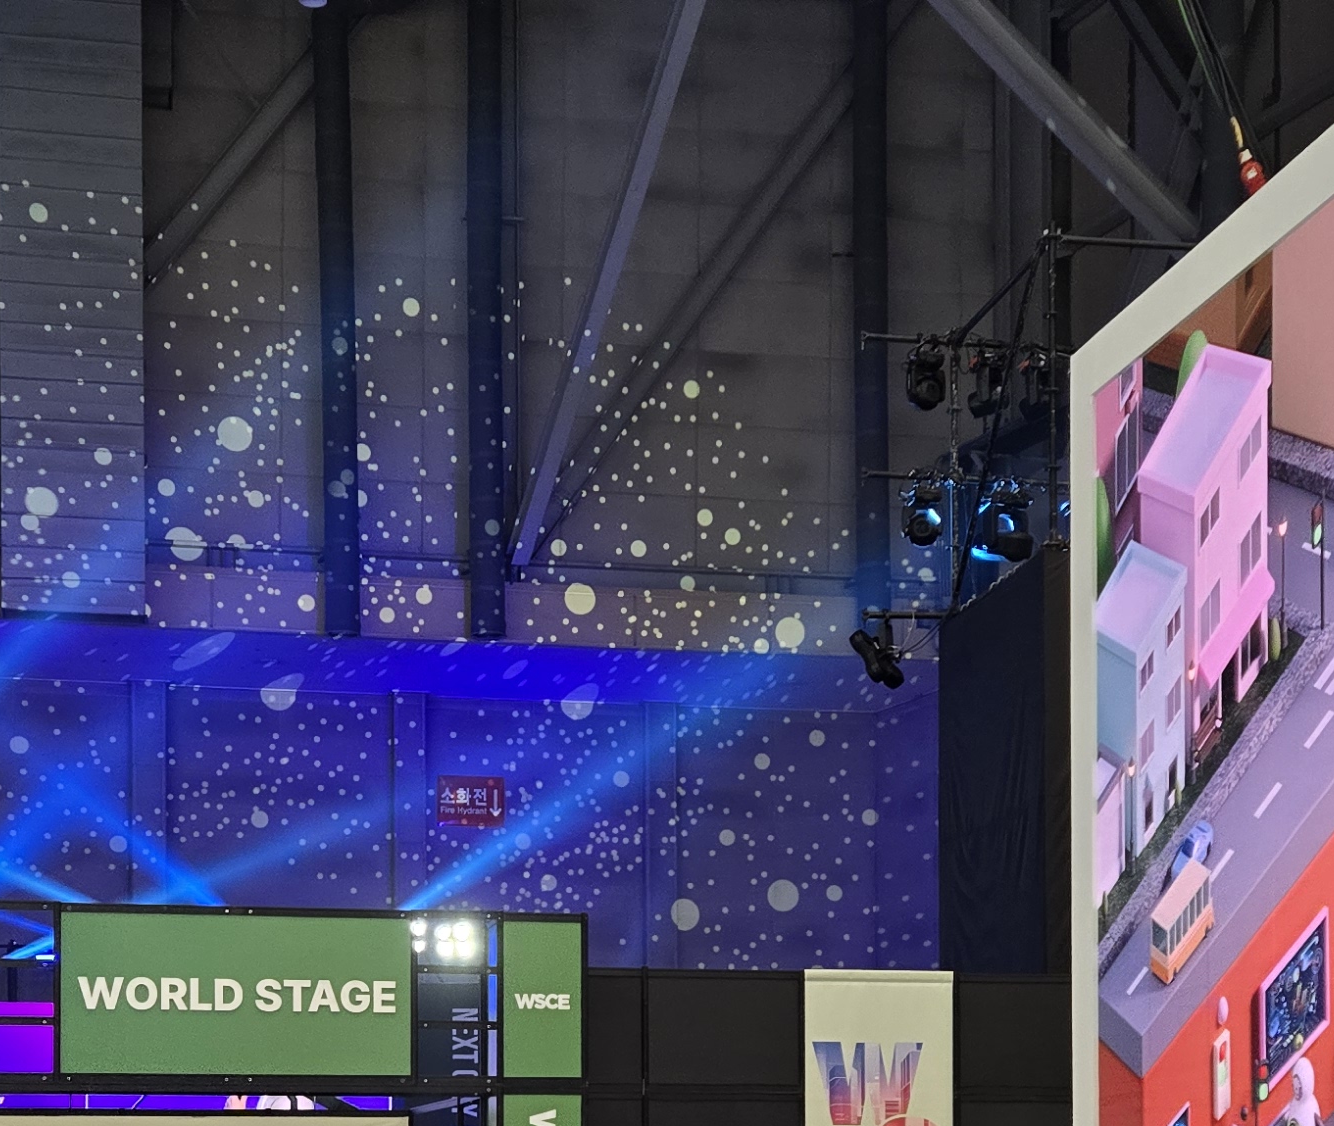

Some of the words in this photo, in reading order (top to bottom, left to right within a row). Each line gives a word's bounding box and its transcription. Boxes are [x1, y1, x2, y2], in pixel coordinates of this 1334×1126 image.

[440, 787, 487, 806] 소화전
[440, 805, 455, 814] Fire
[457, 806, 487, 815] Hydrant
[77, 976, 243, 1011] WORLD
[255, 978, 397, 1013] STAGE
[515, 993, 571, 1011] WSCE
